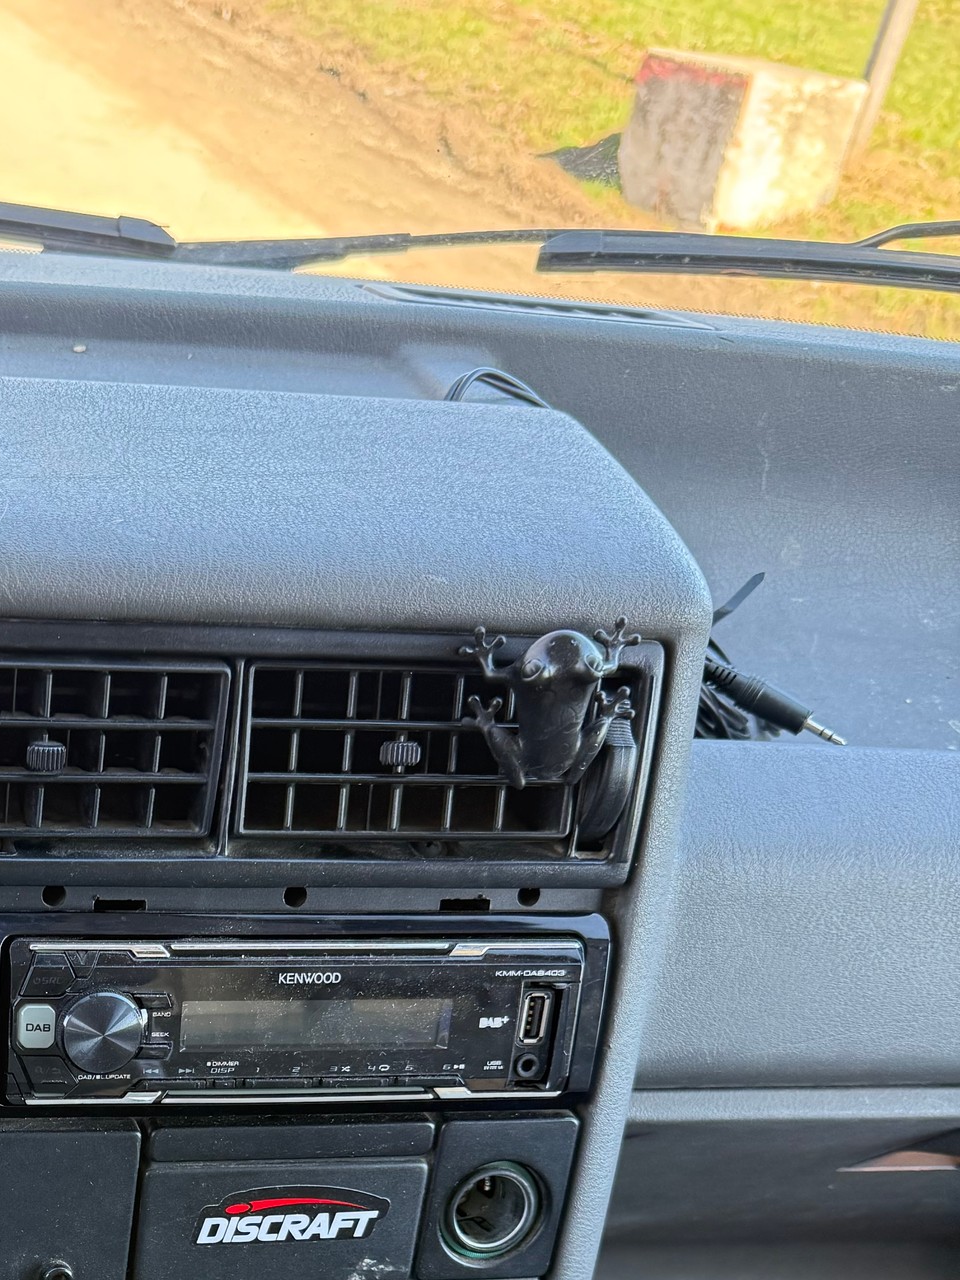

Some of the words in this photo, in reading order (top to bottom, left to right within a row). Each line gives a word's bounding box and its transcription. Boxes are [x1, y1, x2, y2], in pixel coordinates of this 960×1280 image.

[278, 972, 342, 984] KENWOOD
[495, 969, 567, 977] KMM-DAB403
[25, 1022, 51, 1033] DAB
[196, 1210, 379, 1244] DISCRAFT
